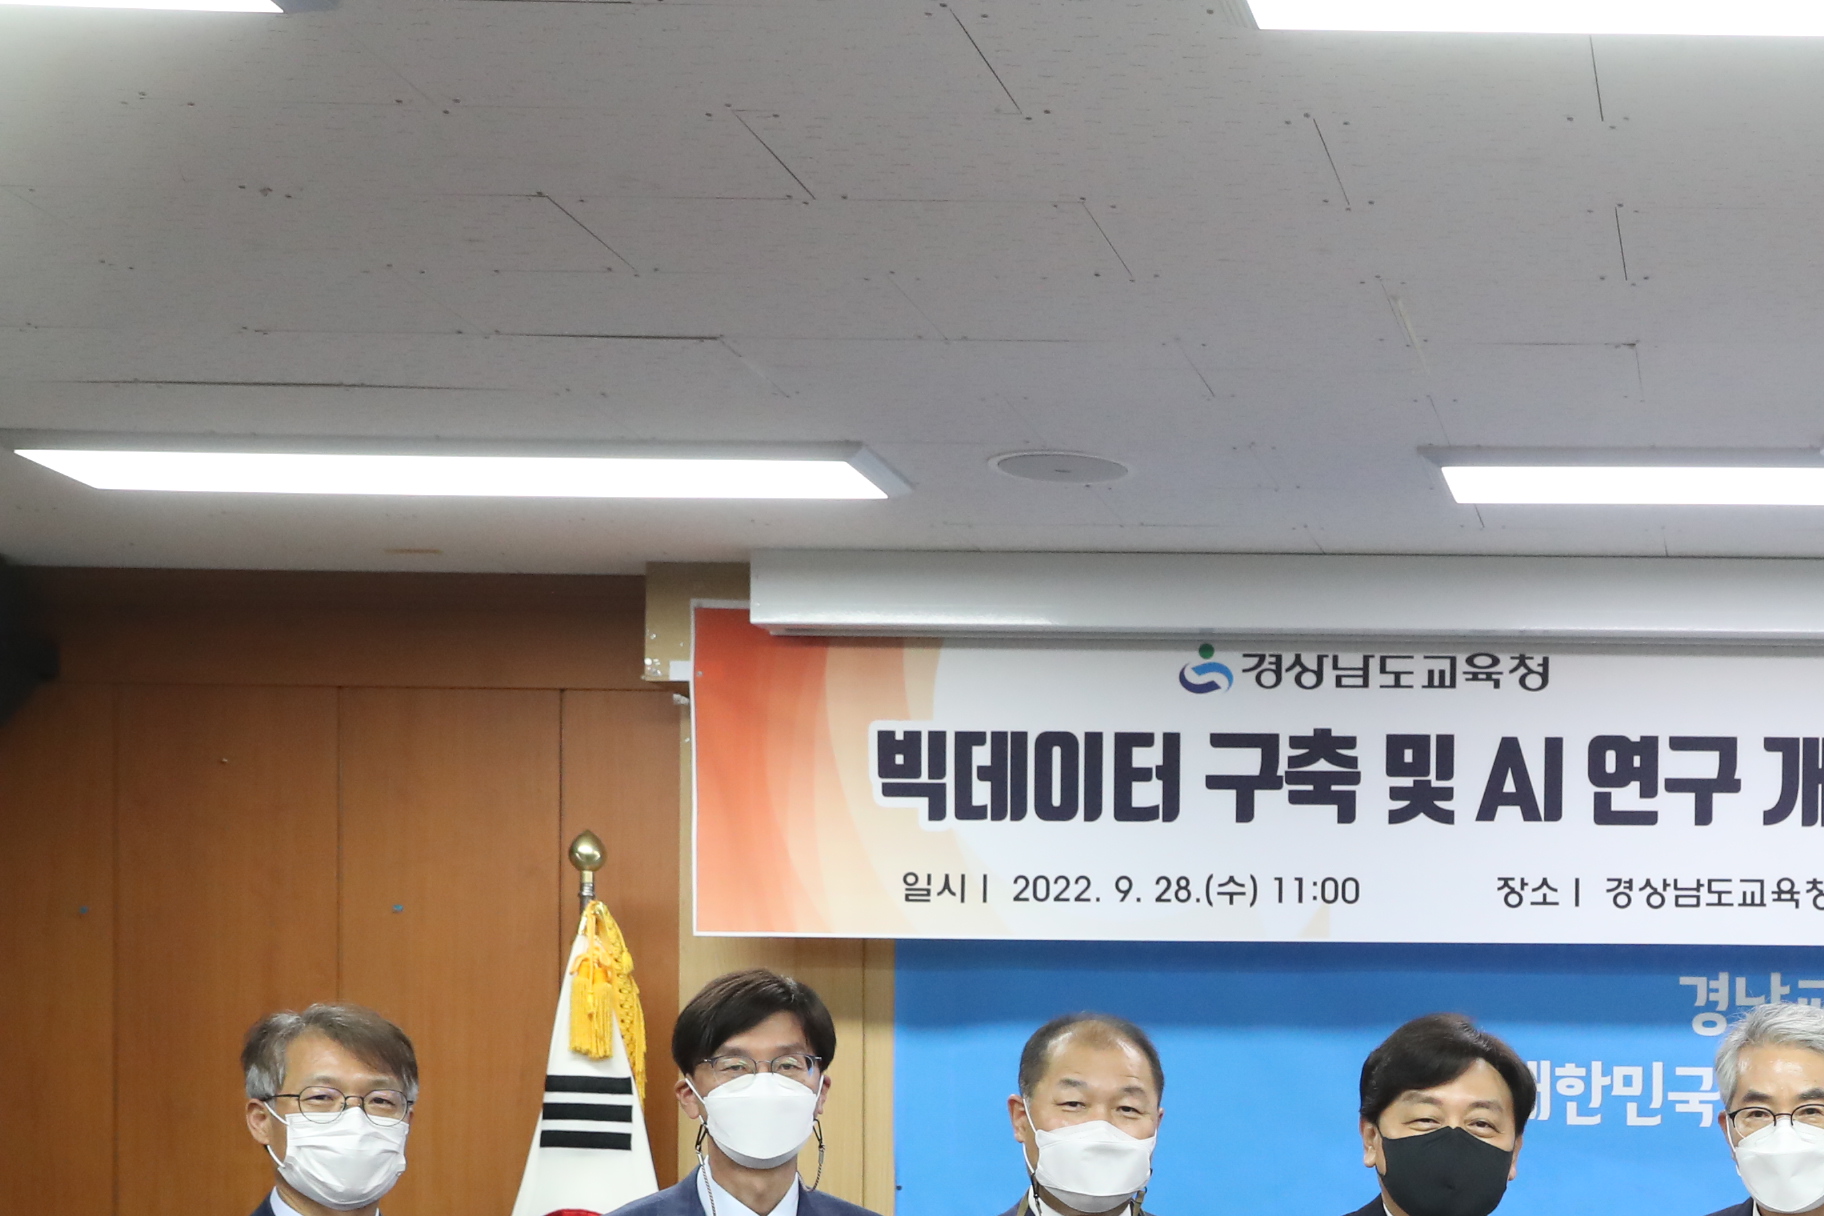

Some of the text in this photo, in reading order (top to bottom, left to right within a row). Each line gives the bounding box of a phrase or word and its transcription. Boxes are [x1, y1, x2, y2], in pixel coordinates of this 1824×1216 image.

[1241, 652, 1550, 692] 경상남도교육청
[877, 730, 1181, 823] 빅데이터
[1205, 727, 1362, 824] 구축
[1385, 733, 1455, 825] 및
[1475, 736, 1564, 822] AI
[1587, 734, 1742, 826] 연구
[1013, 874, 1101, 903] 2022.
[1114, 875, 1141, 903] 9.
[1155, 873, 1258, 908] 28.(수)
[1273, 876, 1360, 905] 11:00
